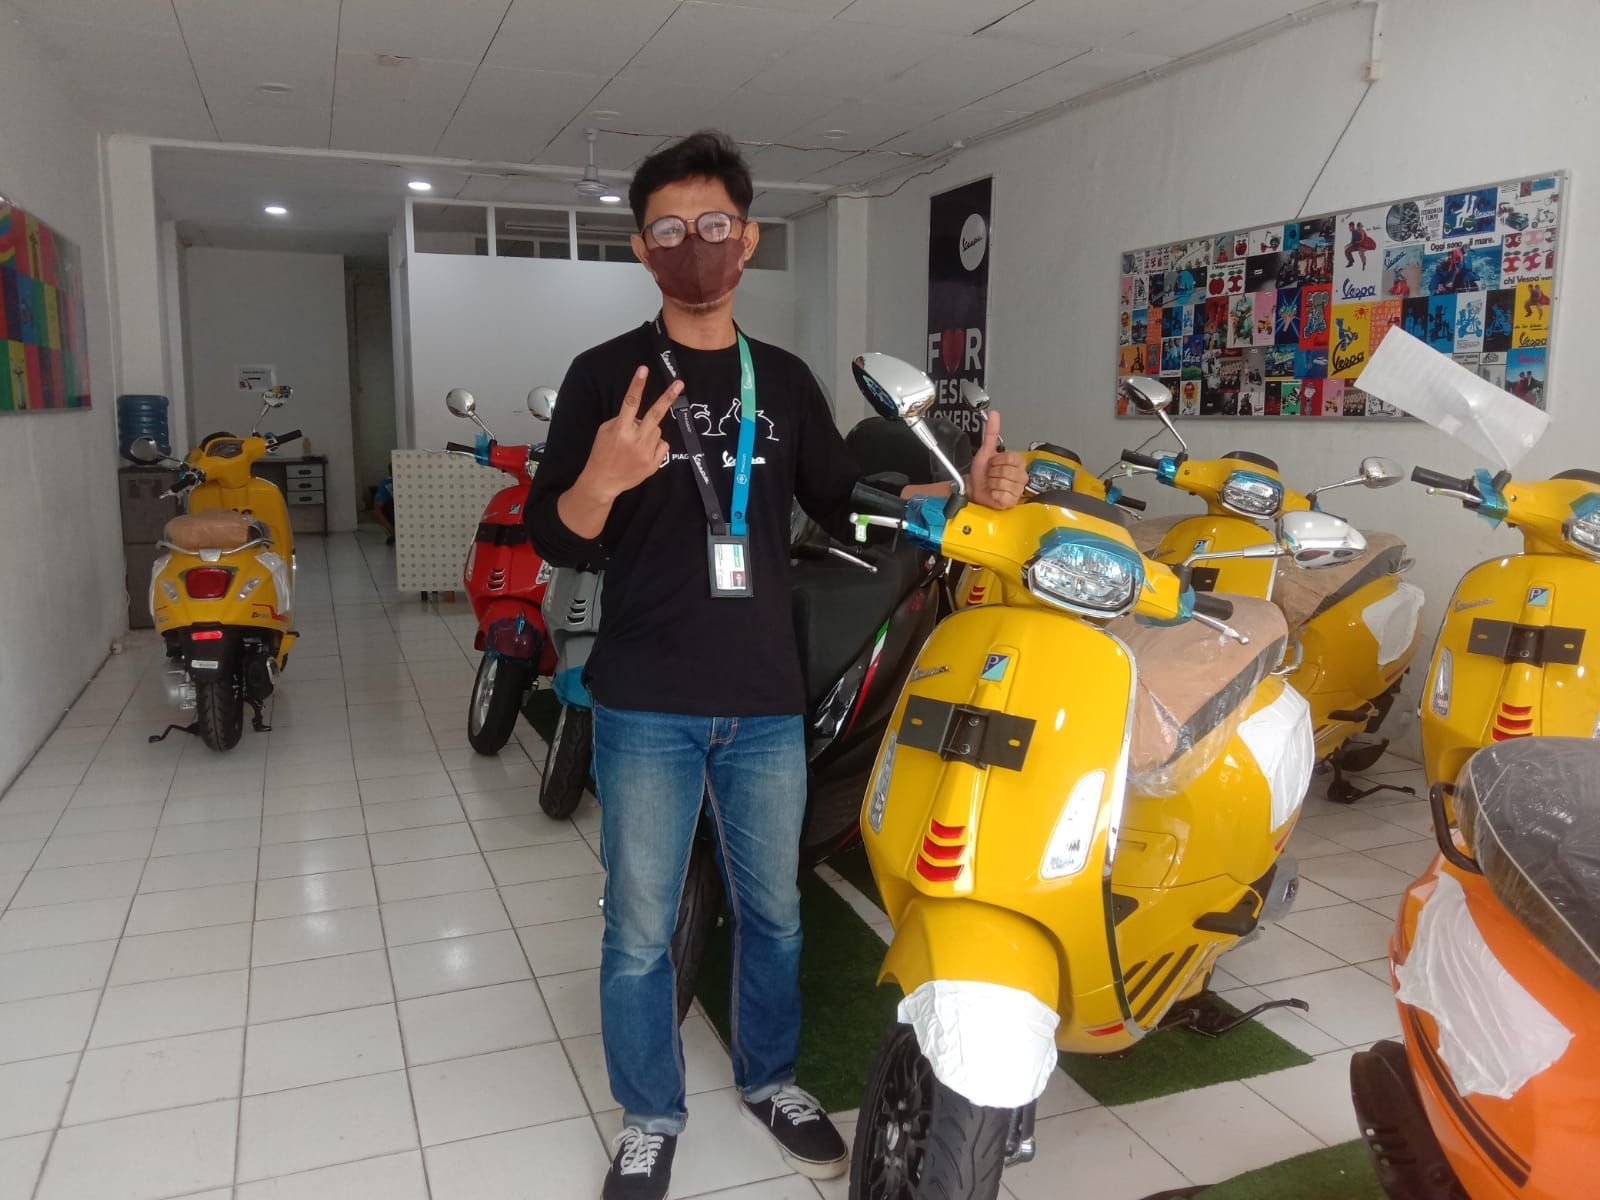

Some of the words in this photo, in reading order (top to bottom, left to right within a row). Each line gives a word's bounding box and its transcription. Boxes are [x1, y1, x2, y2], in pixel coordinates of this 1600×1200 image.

[962, 237, 983, 252] Vespa
[1430, 242, 1446, 253] Oggi
[1341, 278, 1376, 300] Vespa
[1519, 332, 1547, 348] Vespa
[1330, 340, 1365, 376] Vespa
[722, 449, 766, 468] Vea
[692, 453, 710, 485] Vespa
[984, 655, 1000, 671] P
